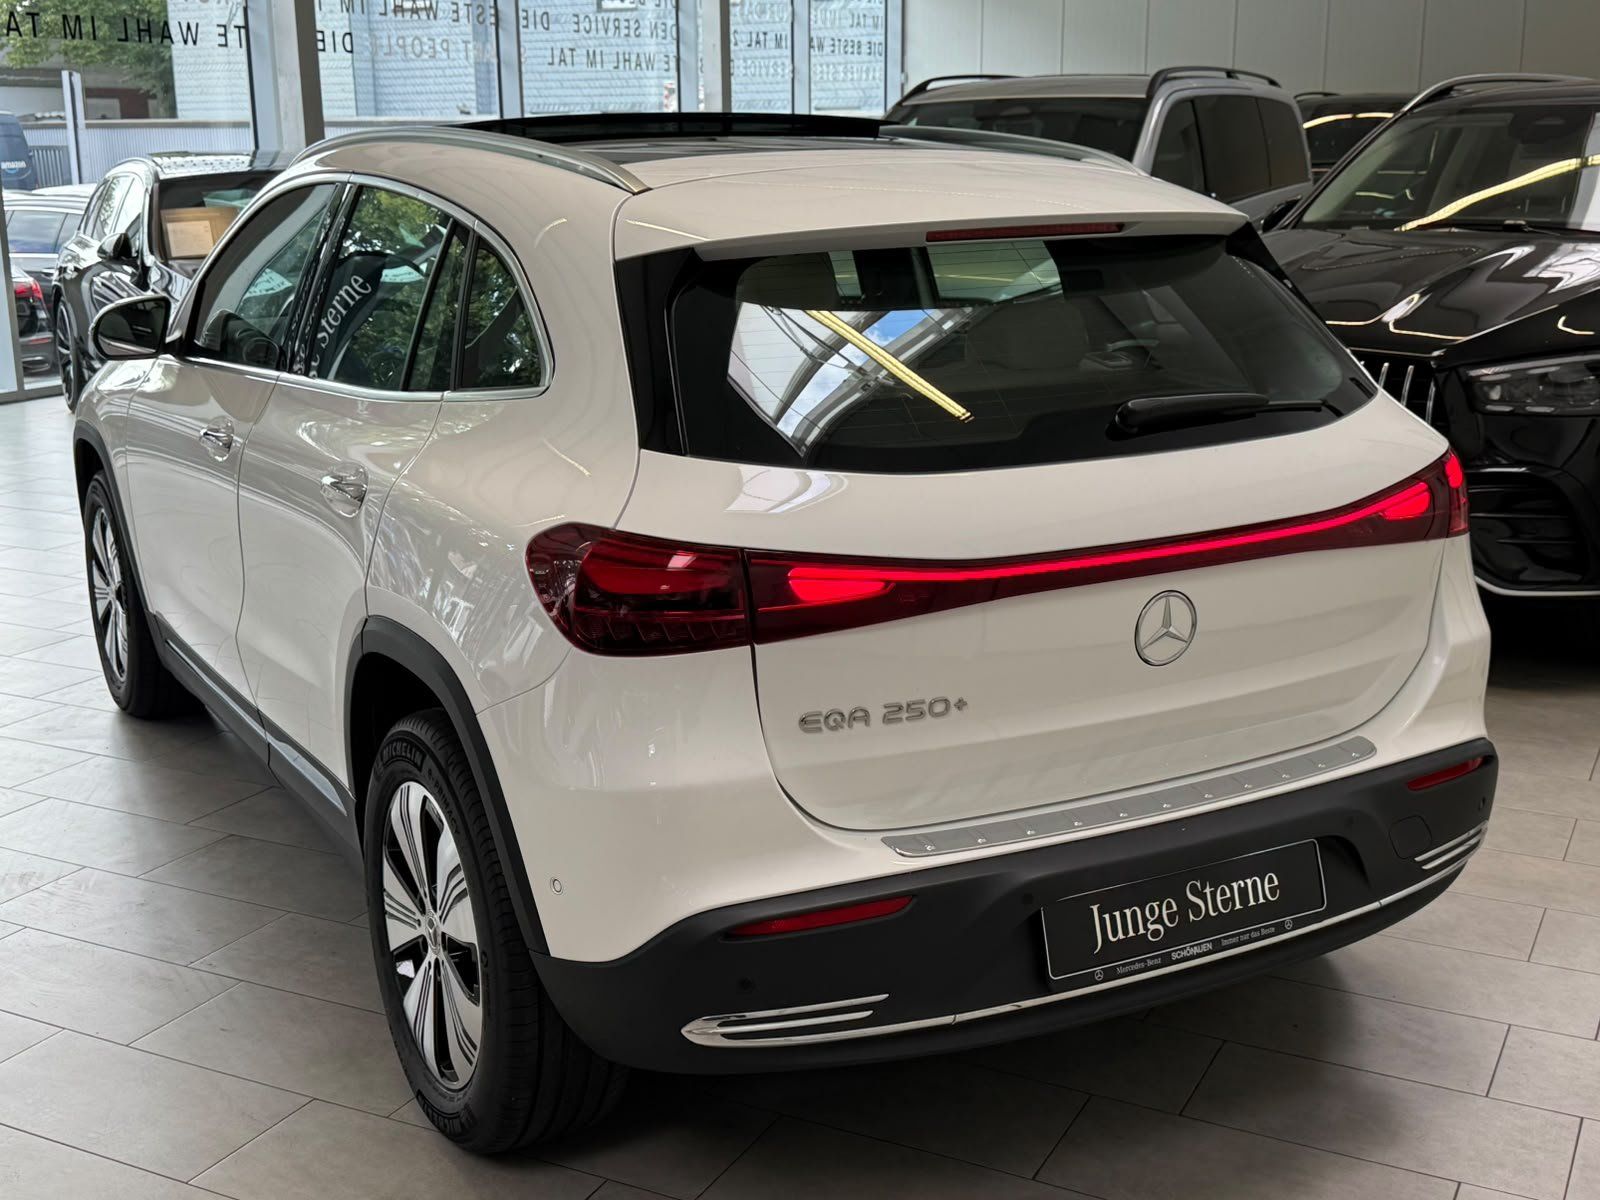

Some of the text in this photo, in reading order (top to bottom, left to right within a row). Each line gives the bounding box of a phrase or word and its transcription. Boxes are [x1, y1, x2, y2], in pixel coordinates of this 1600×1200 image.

[799, 696, 968, 734] EQA 250+
[1090, 872, 1280, 954] Junge Sterne
[1116, 957, 1163, 976] Mercedes-Benz
